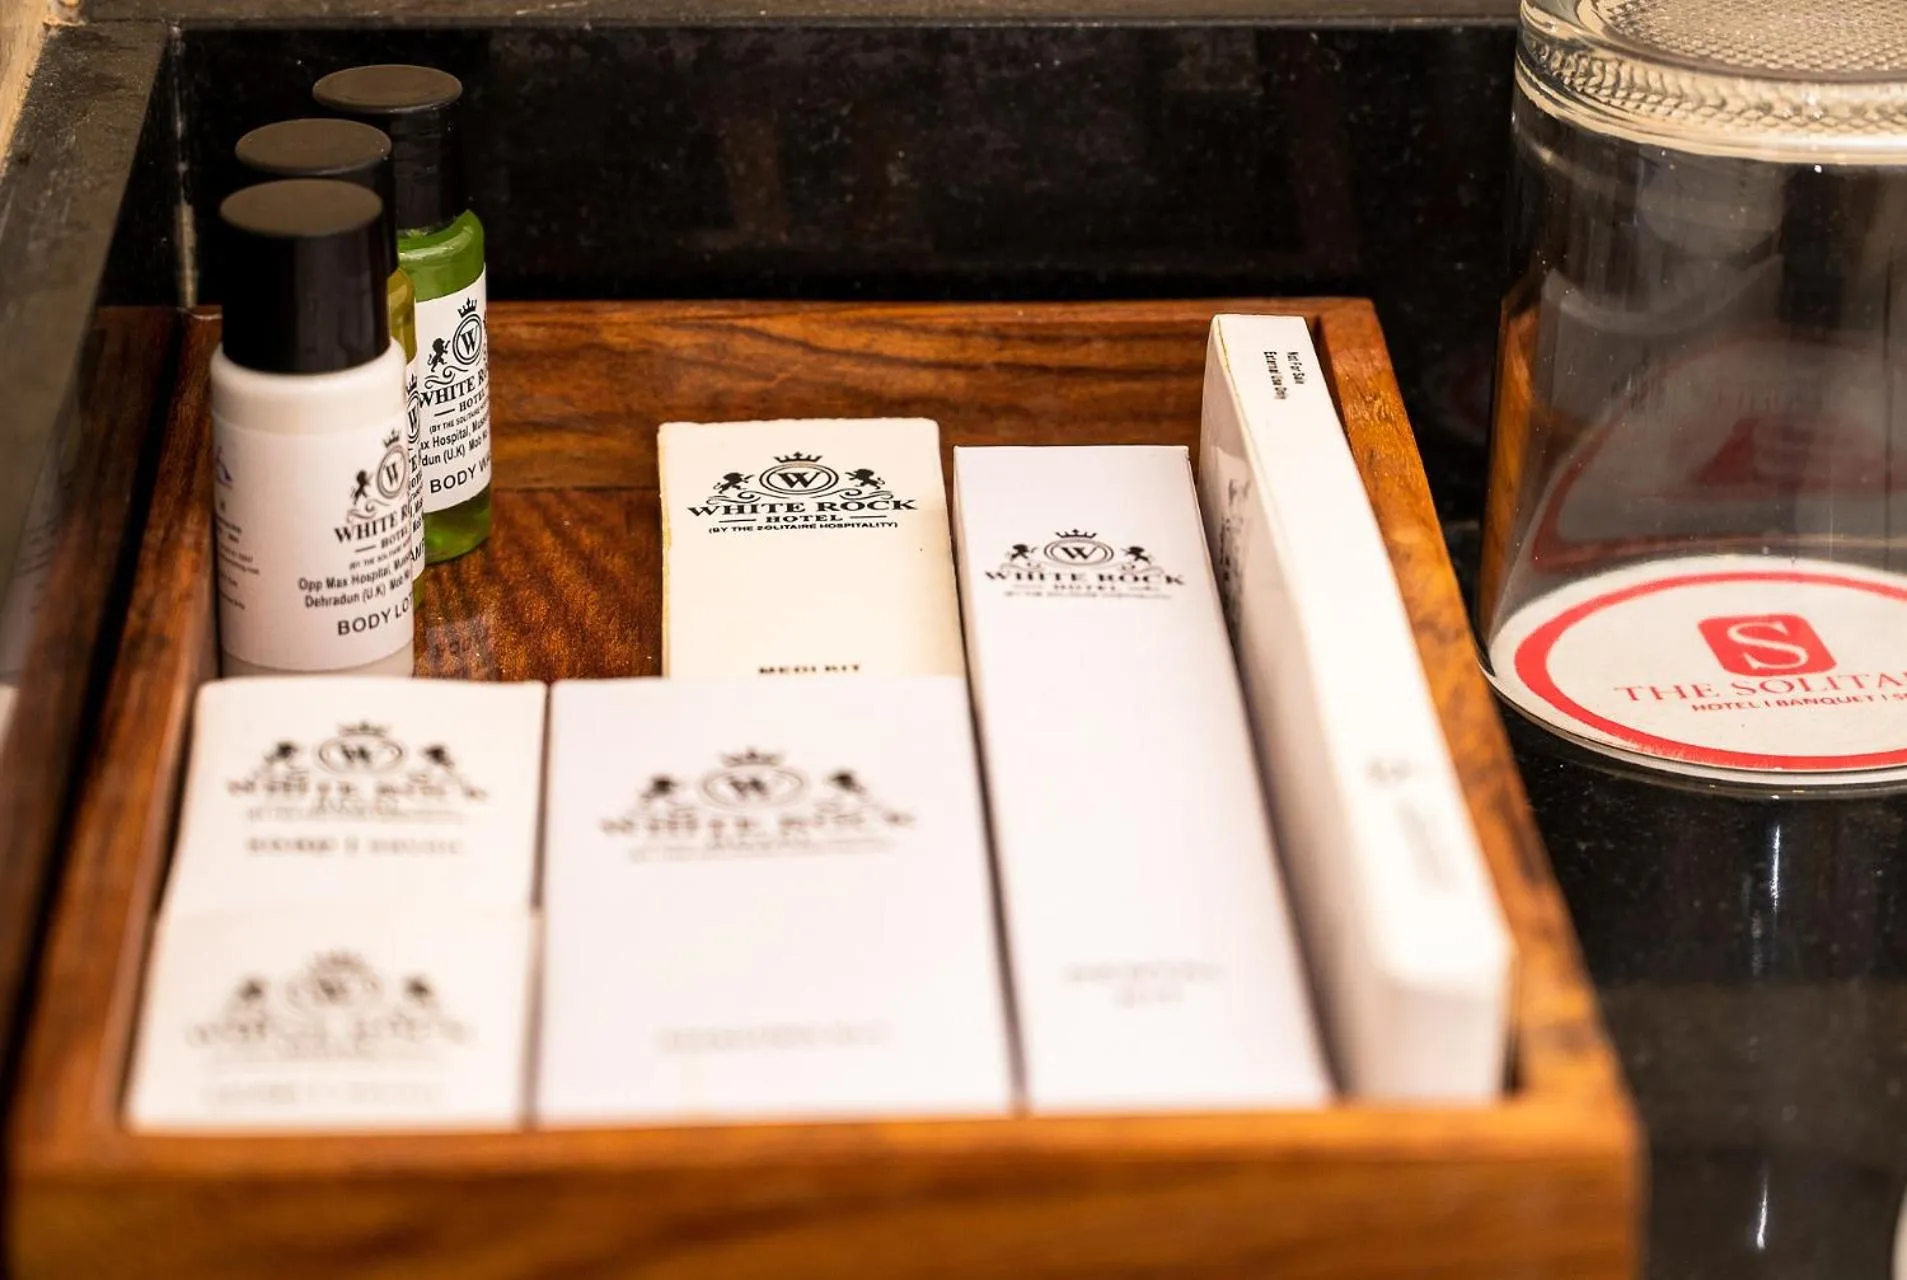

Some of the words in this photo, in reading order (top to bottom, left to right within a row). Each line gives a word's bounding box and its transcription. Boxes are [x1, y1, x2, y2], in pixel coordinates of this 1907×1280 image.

[460, 328, 478, 356] W
[419, 375, 476, 409] WHITE
[459, 389, 488, 412] HOTE
[386, 464, 399, 486] W
[430, 463, 477, 494] BODY
[777, 472, 821, 489] W
[687, 501, 806, 517] WHITE
[816, 498, 918, 513] ROCK
[334, 508, 399, 543] WHITE
[756, 522, 817, 532] SOLITAIRE
[819, 520, 898, 530] HOSPITALITY)
[765, 514, 844, 524] HOTEL
[1060, 546, 1102, 560] W
[297, 577, 323, 593] Opp
[326, 576, 348, 590] Max
[304, 592, 360, 609] Dehradun
[337, 606, 391, 637] BODY
[1727, 621, 1809, 669] S
[1613, 683, 1722, 703] THE
[1730, 671, 1907, 697] SOLITA
[1691, 699, 1763, 713] HOTEL
[1775, 694, 1876, 709] BANQUET
